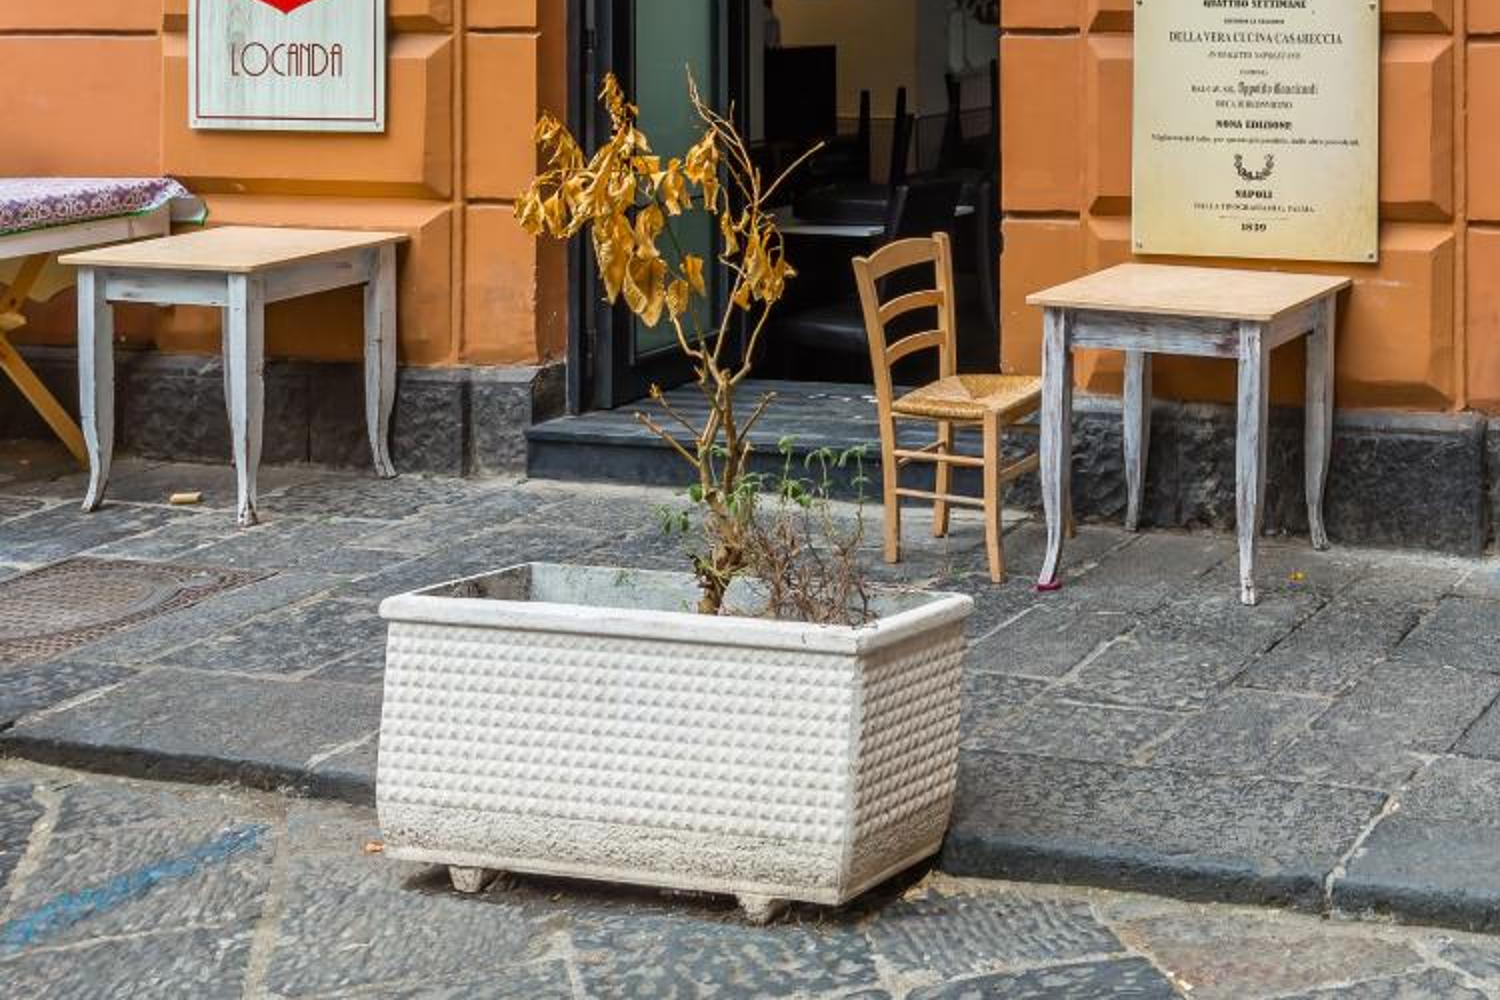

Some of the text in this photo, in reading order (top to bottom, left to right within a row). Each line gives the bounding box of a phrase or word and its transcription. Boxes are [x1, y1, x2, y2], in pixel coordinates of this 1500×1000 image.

[1203, 0, 1307, 9] QUATTRO SETTIMANE
[1169, 31, 1202, 43] DELLA
[1203, 31, 1232, 44] VERA
[1233, 31, 1273, 44] CUCINA
[230, 42, 343, 77] LOCANDA
[1235, 189, 1273, 199] NAPOLI
